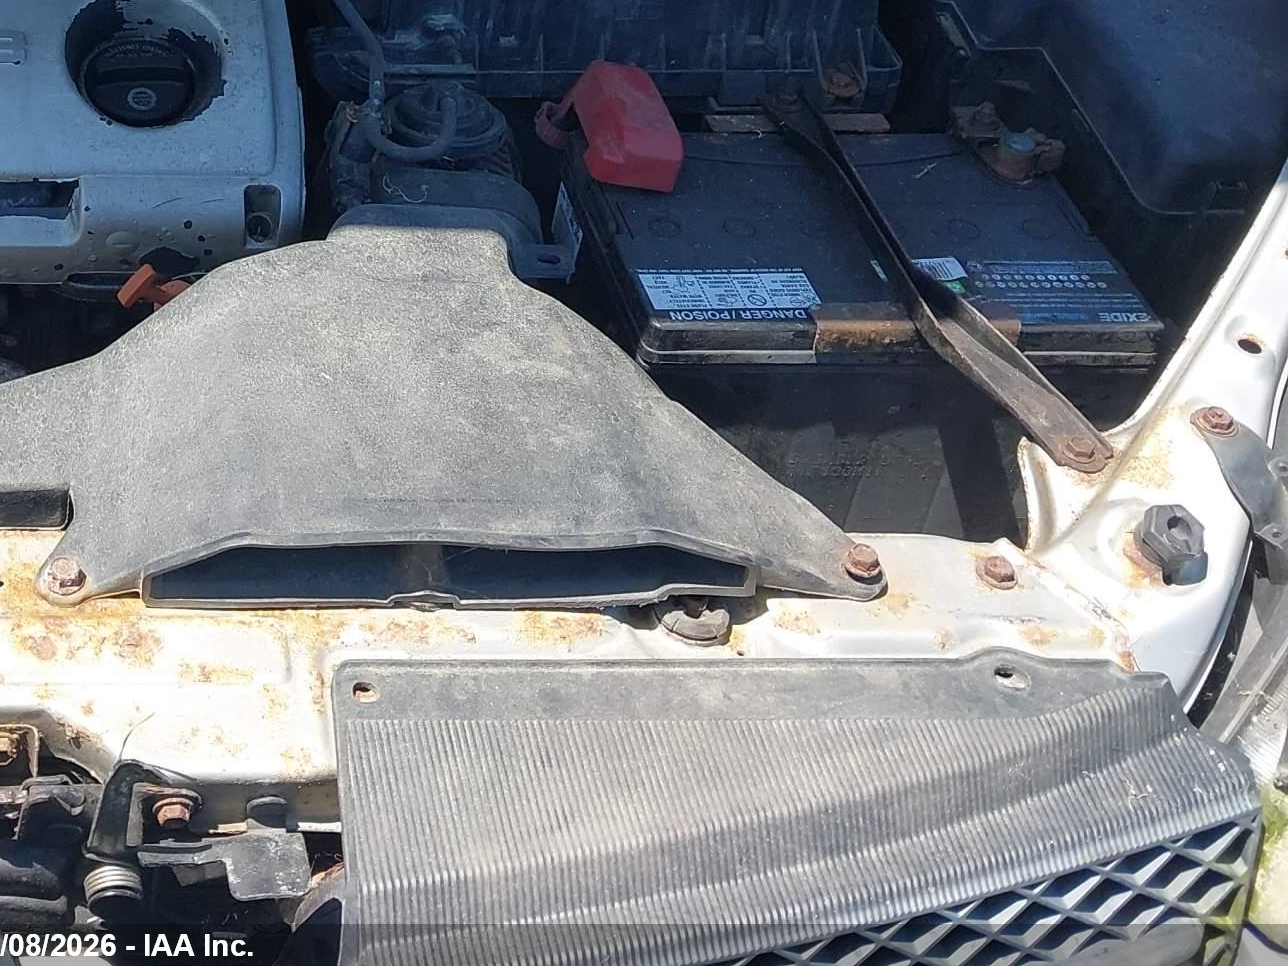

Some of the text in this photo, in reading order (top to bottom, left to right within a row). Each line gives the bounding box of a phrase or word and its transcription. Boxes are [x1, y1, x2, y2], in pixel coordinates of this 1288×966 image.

[669, 311, 731, 321] POISON
[740, 309, 807, 320] DANGER
[1099, 312, 1150, 322] EXIDE
